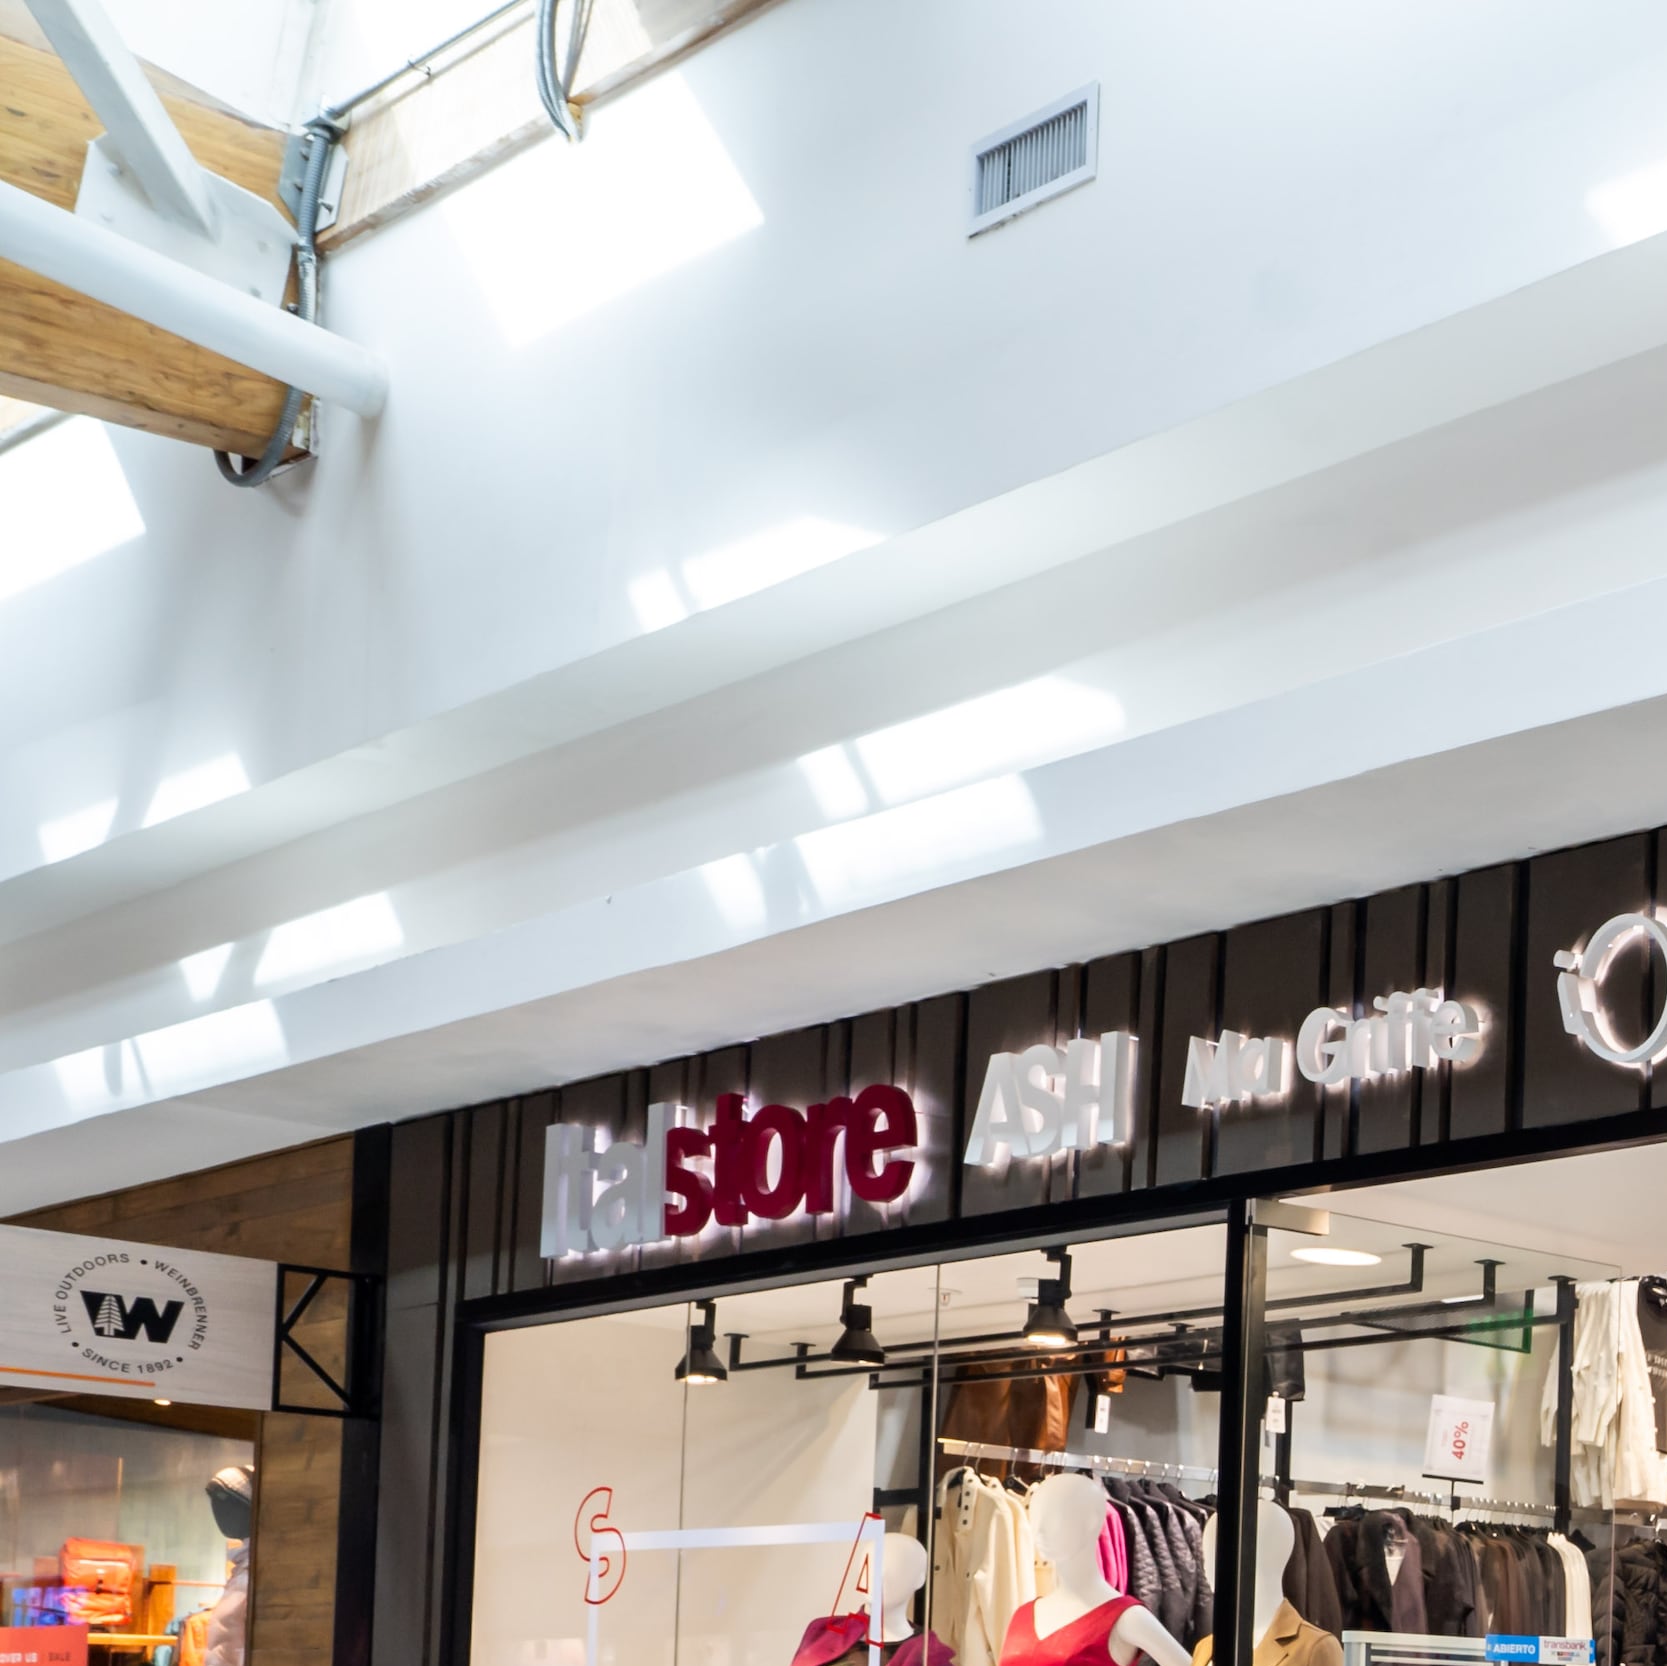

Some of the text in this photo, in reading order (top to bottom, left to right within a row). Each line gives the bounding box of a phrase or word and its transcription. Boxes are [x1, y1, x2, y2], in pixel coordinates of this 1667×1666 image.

[1182, 987, 1480, 1108] Ma Griffe
[963, 1031, 1134, 1166] ASH
[540, 1083, 918, 1260] Italstore
[53, 1252, 131, 1335] LIVE OUTDOORS
[154, 1260, 209, 1351] WEINBRENNER
[81, 1347, 174, 1375] SINCE 1892
[1451, 1420, 1470, 1461] 40%
[1492, 1642, 1537, 1655] ABIERTO
